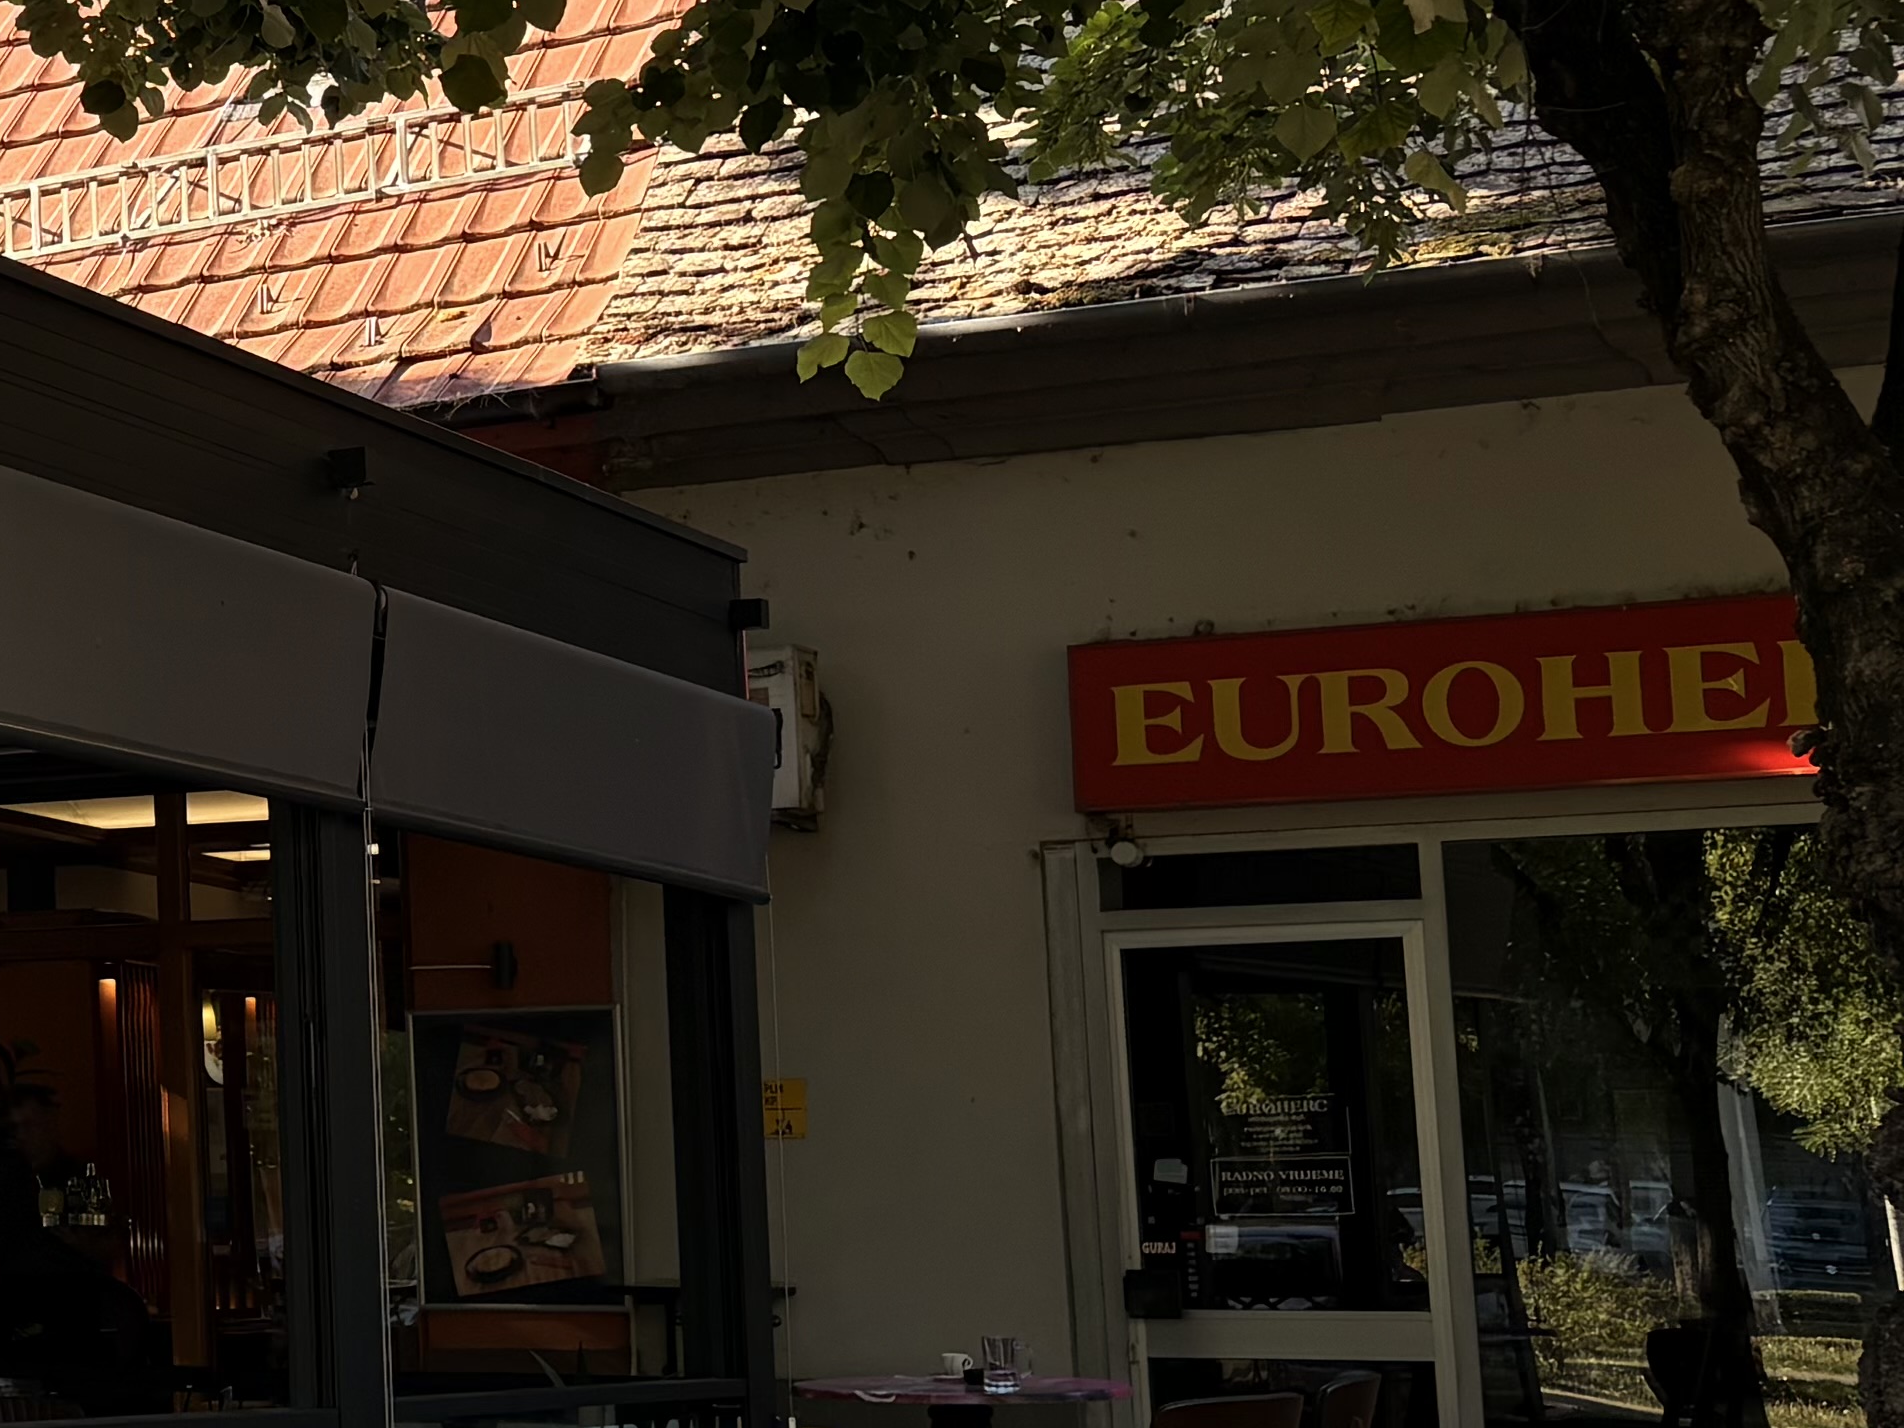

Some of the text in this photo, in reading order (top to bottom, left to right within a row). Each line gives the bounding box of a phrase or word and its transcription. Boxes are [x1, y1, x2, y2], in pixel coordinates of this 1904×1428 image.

[1221, 1169, 1345, 1182] RADNO VRIJEME
[1141, 1241, 1177, 1254] GURAJ
